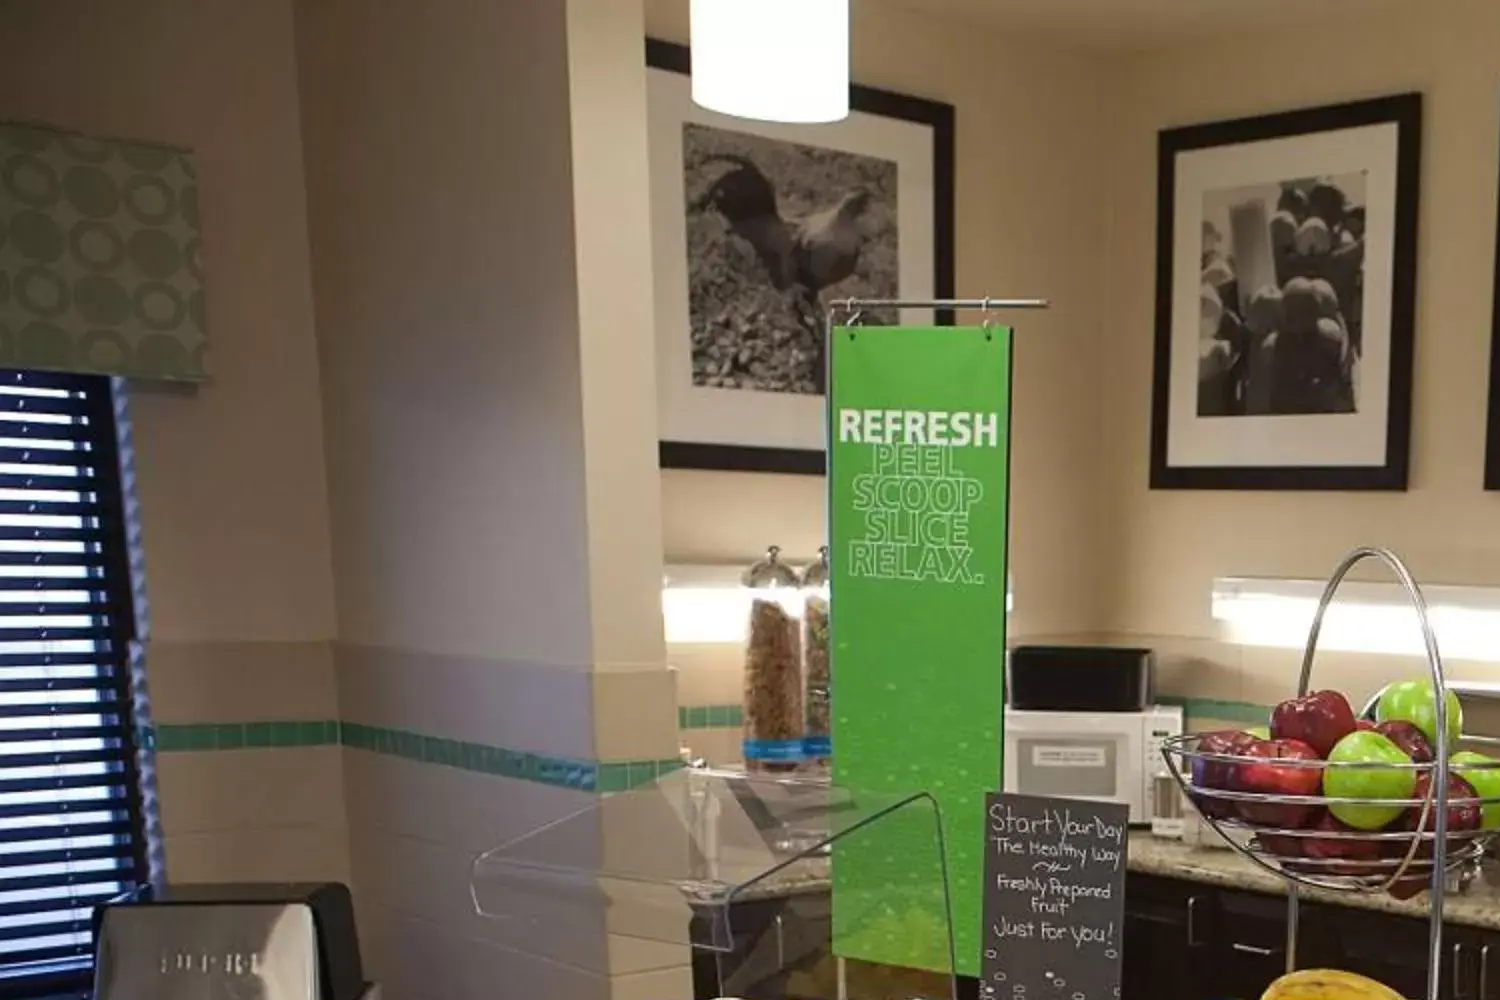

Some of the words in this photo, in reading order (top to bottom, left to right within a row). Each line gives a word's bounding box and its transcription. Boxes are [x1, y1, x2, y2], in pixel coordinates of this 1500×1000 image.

[839, 409, 998, 447] REFRESH
[872, 442, 963, 477] PEEL
[852, 473, 984, 514] SCOOP
[865, 509, 969, 547] SLICE
[848, 540, 985, 585] RELAX.
[989, 803, 1053, 834] Start
[1053, 808, 1094, 846] Your
[1093, 815, 1123, 845] Day
[991, 836, 1025, 854] The
[1030, 840, 1087, 868] Healthy
[1091, 847, 1121, 872] Way
[997, 873, 1047, 898] Freshly
[1049, 877, 1111, 903] Prepared
[1031, 897, 1070, 917] Fruit
[993, 915, 1034, 937] Just
